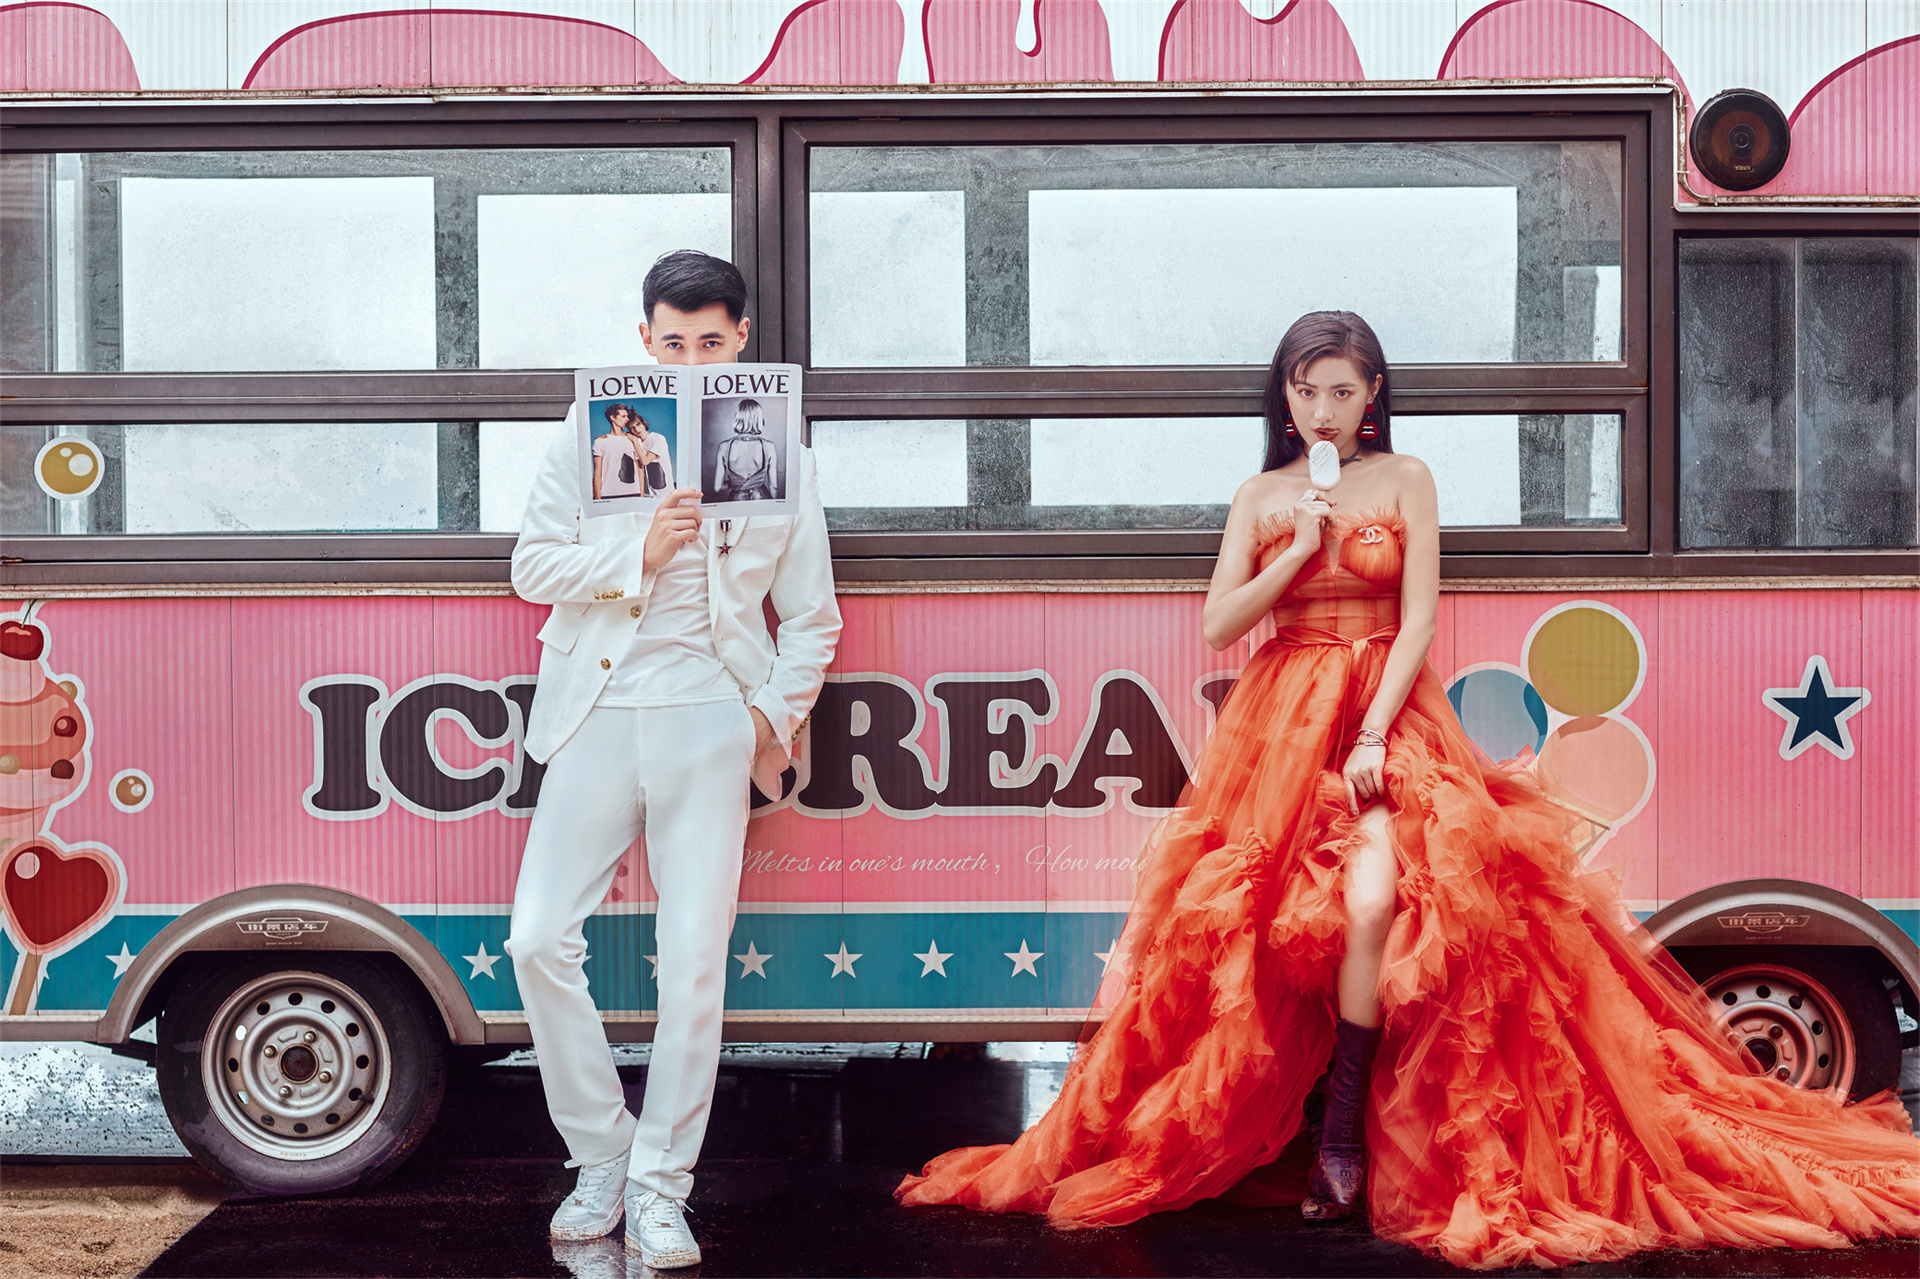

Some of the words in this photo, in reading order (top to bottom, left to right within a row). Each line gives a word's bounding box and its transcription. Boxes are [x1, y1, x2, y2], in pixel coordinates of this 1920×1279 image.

[589, 376, 677, 398] LOEWE
[703, 374, 789, 395] LOEWE
[750, 670, 1236, 818] REA
[742, 849, 814, 873] Melts
[819, 856, 845, 872] in
[849, 855, 906, 872] one's
[1025, 844, 1088, 873] How
[1094, 857, 1150, 871] mou
